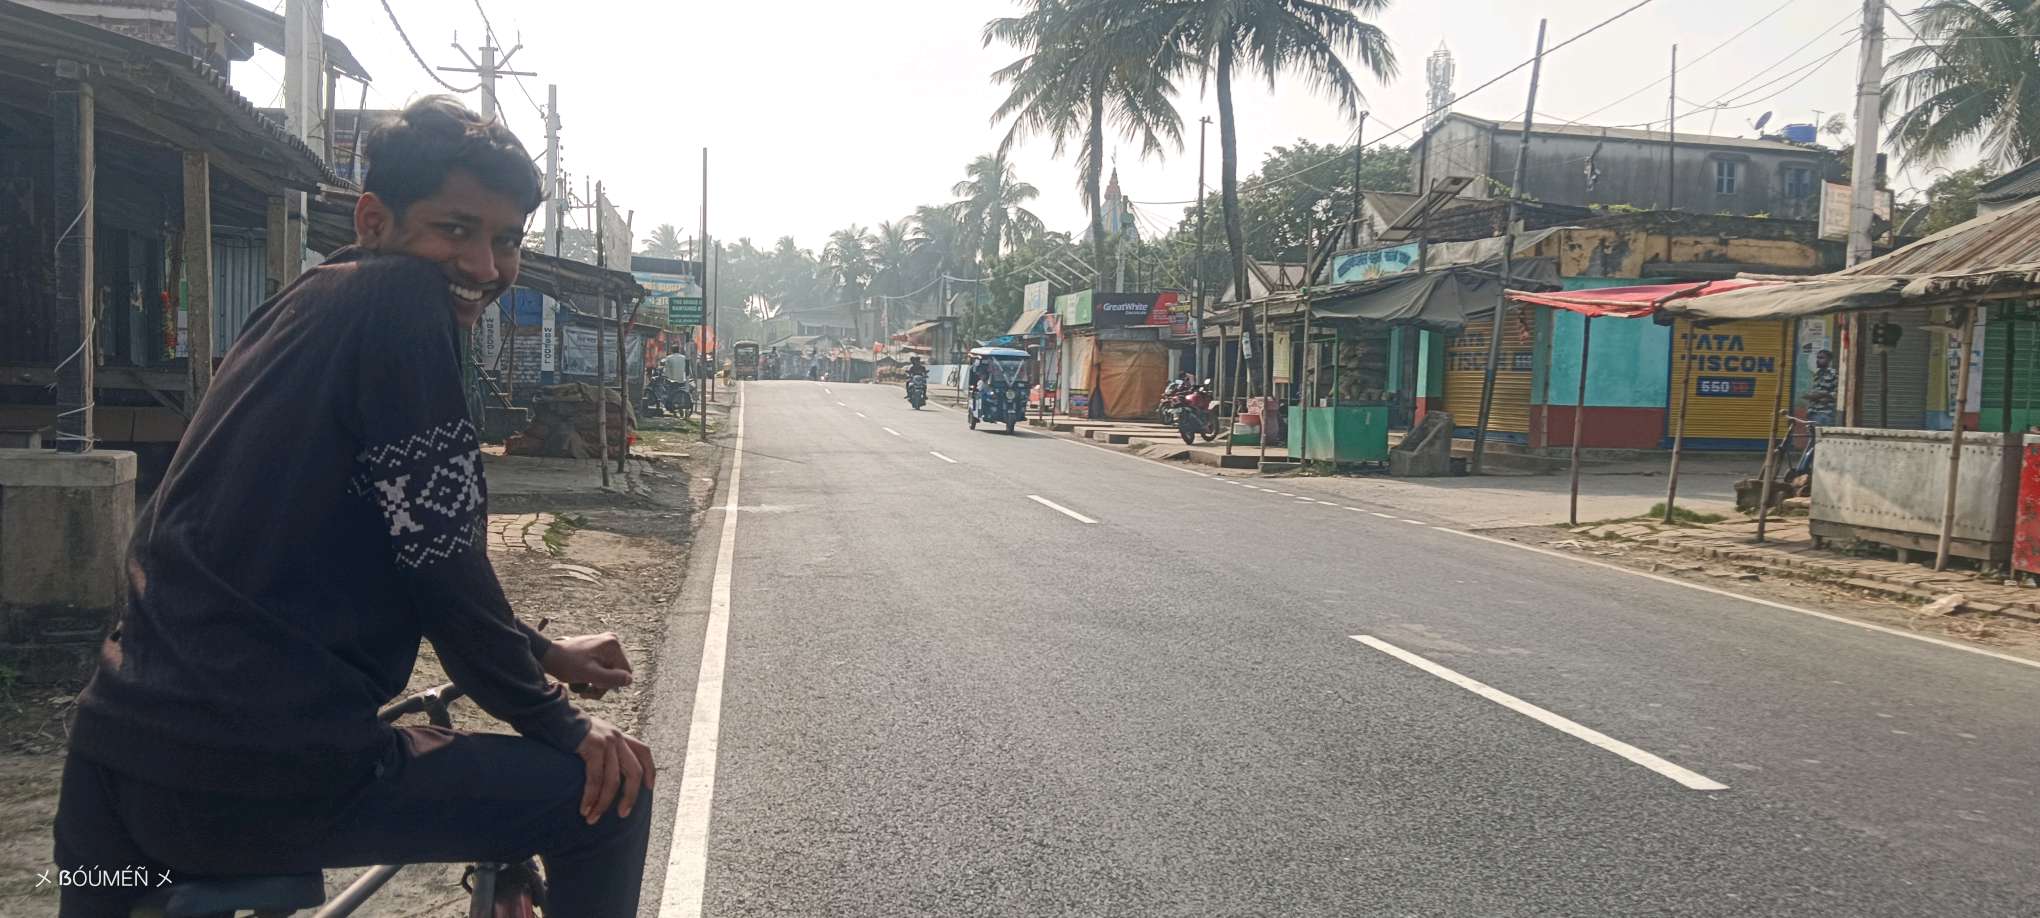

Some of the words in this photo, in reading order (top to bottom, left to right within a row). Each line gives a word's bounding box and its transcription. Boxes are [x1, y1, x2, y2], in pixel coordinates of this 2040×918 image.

[1103, 302, 1149, 311] GreatWhite
[1681, 333, 1745, 351] TATA
[1681, 354, 1775, 373] TISCON
